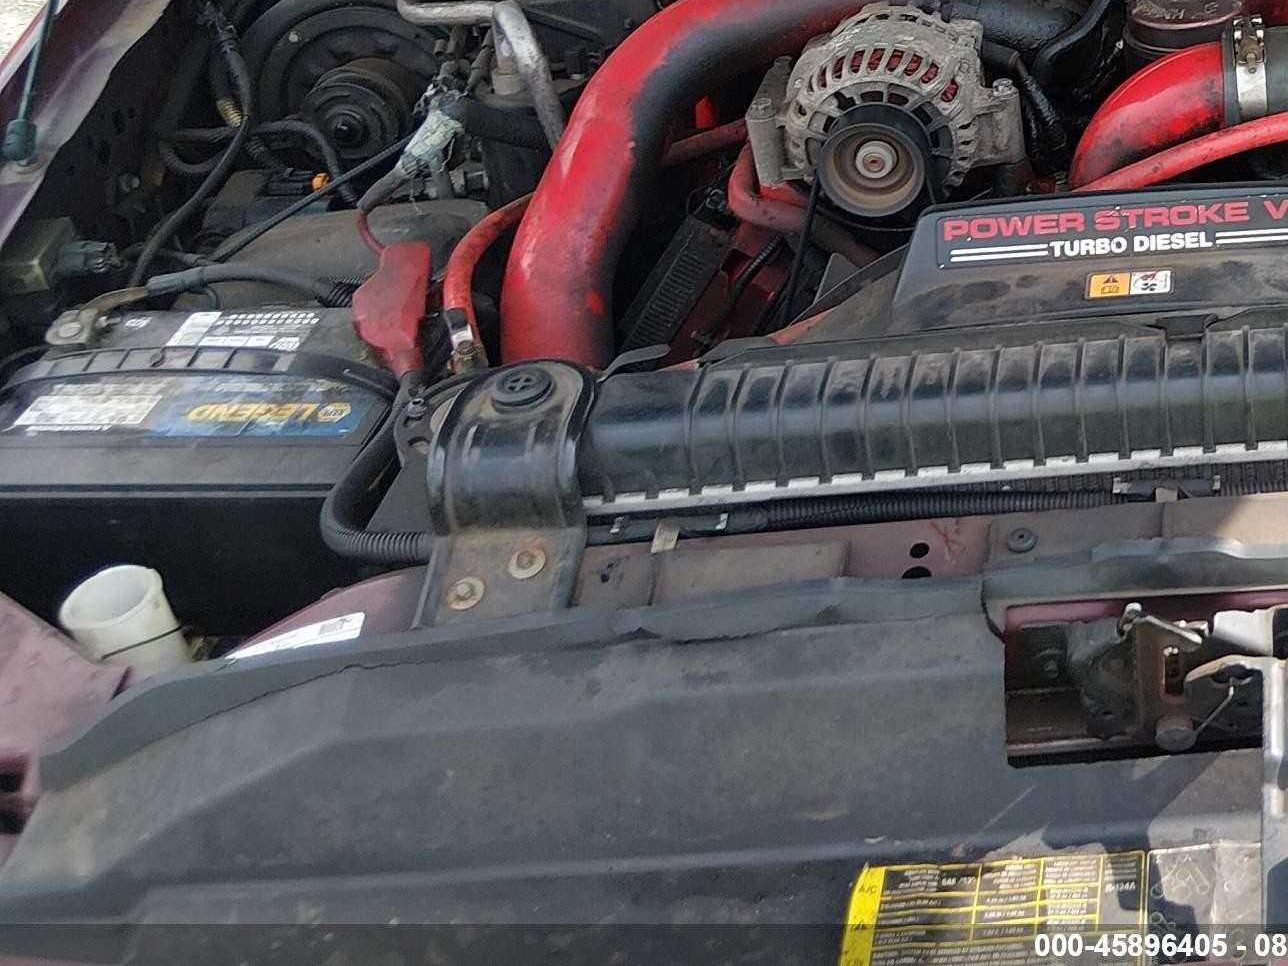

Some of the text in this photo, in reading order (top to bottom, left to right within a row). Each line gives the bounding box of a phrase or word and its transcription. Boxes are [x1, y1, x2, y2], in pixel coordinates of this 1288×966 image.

[943, 211, 1086, 242] POWER
[1094, 201, 1250, 231] STROKE
[1048, 231, 1213, 259] TURBO DIESEL
[185, 402, 321, 423] LEGEND
